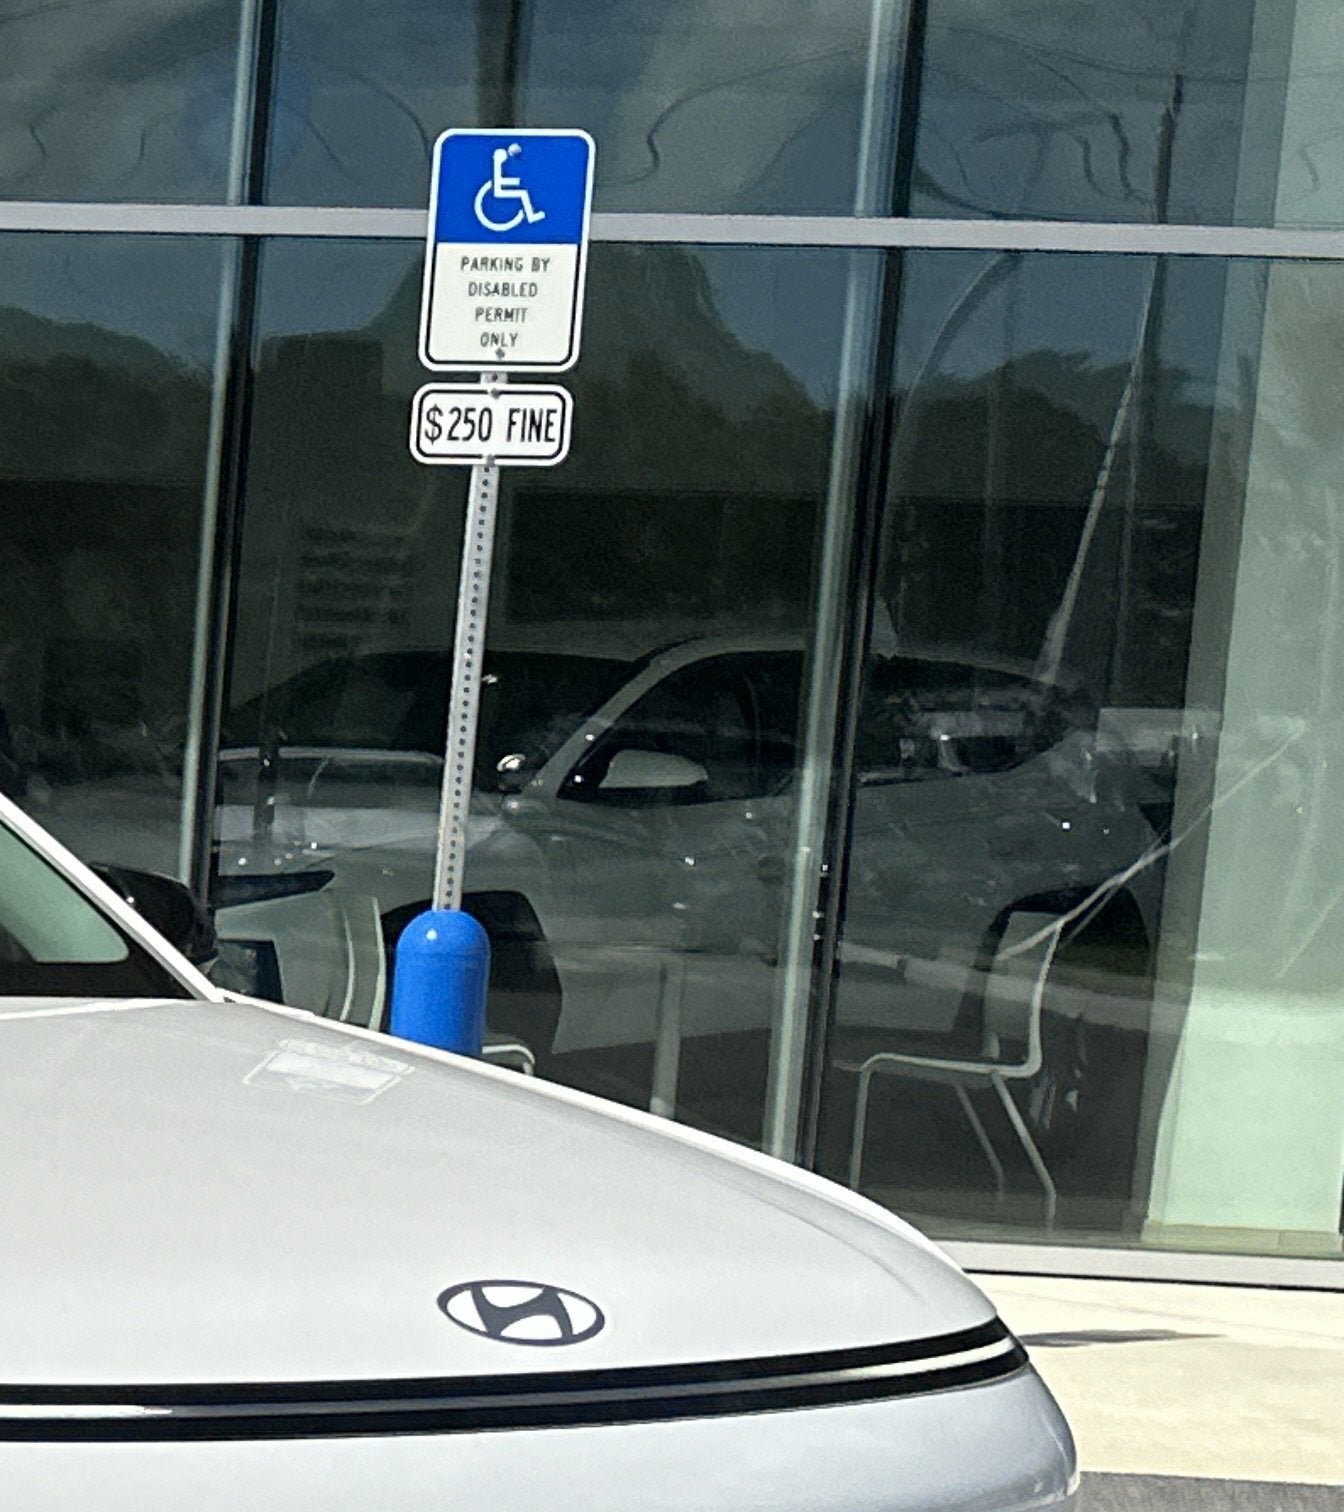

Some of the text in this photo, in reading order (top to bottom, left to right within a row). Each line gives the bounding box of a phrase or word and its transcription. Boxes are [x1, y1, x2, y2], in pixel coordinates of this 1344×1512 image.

[460, 257, 551, 272] PARKING BY
[468, 282, 538, 297] DISABLED
[475, 307, 528, 322] PERMIT
[480, 333, 519, 348] ONLY
[424, 404, 558, 444] $250 FINE
